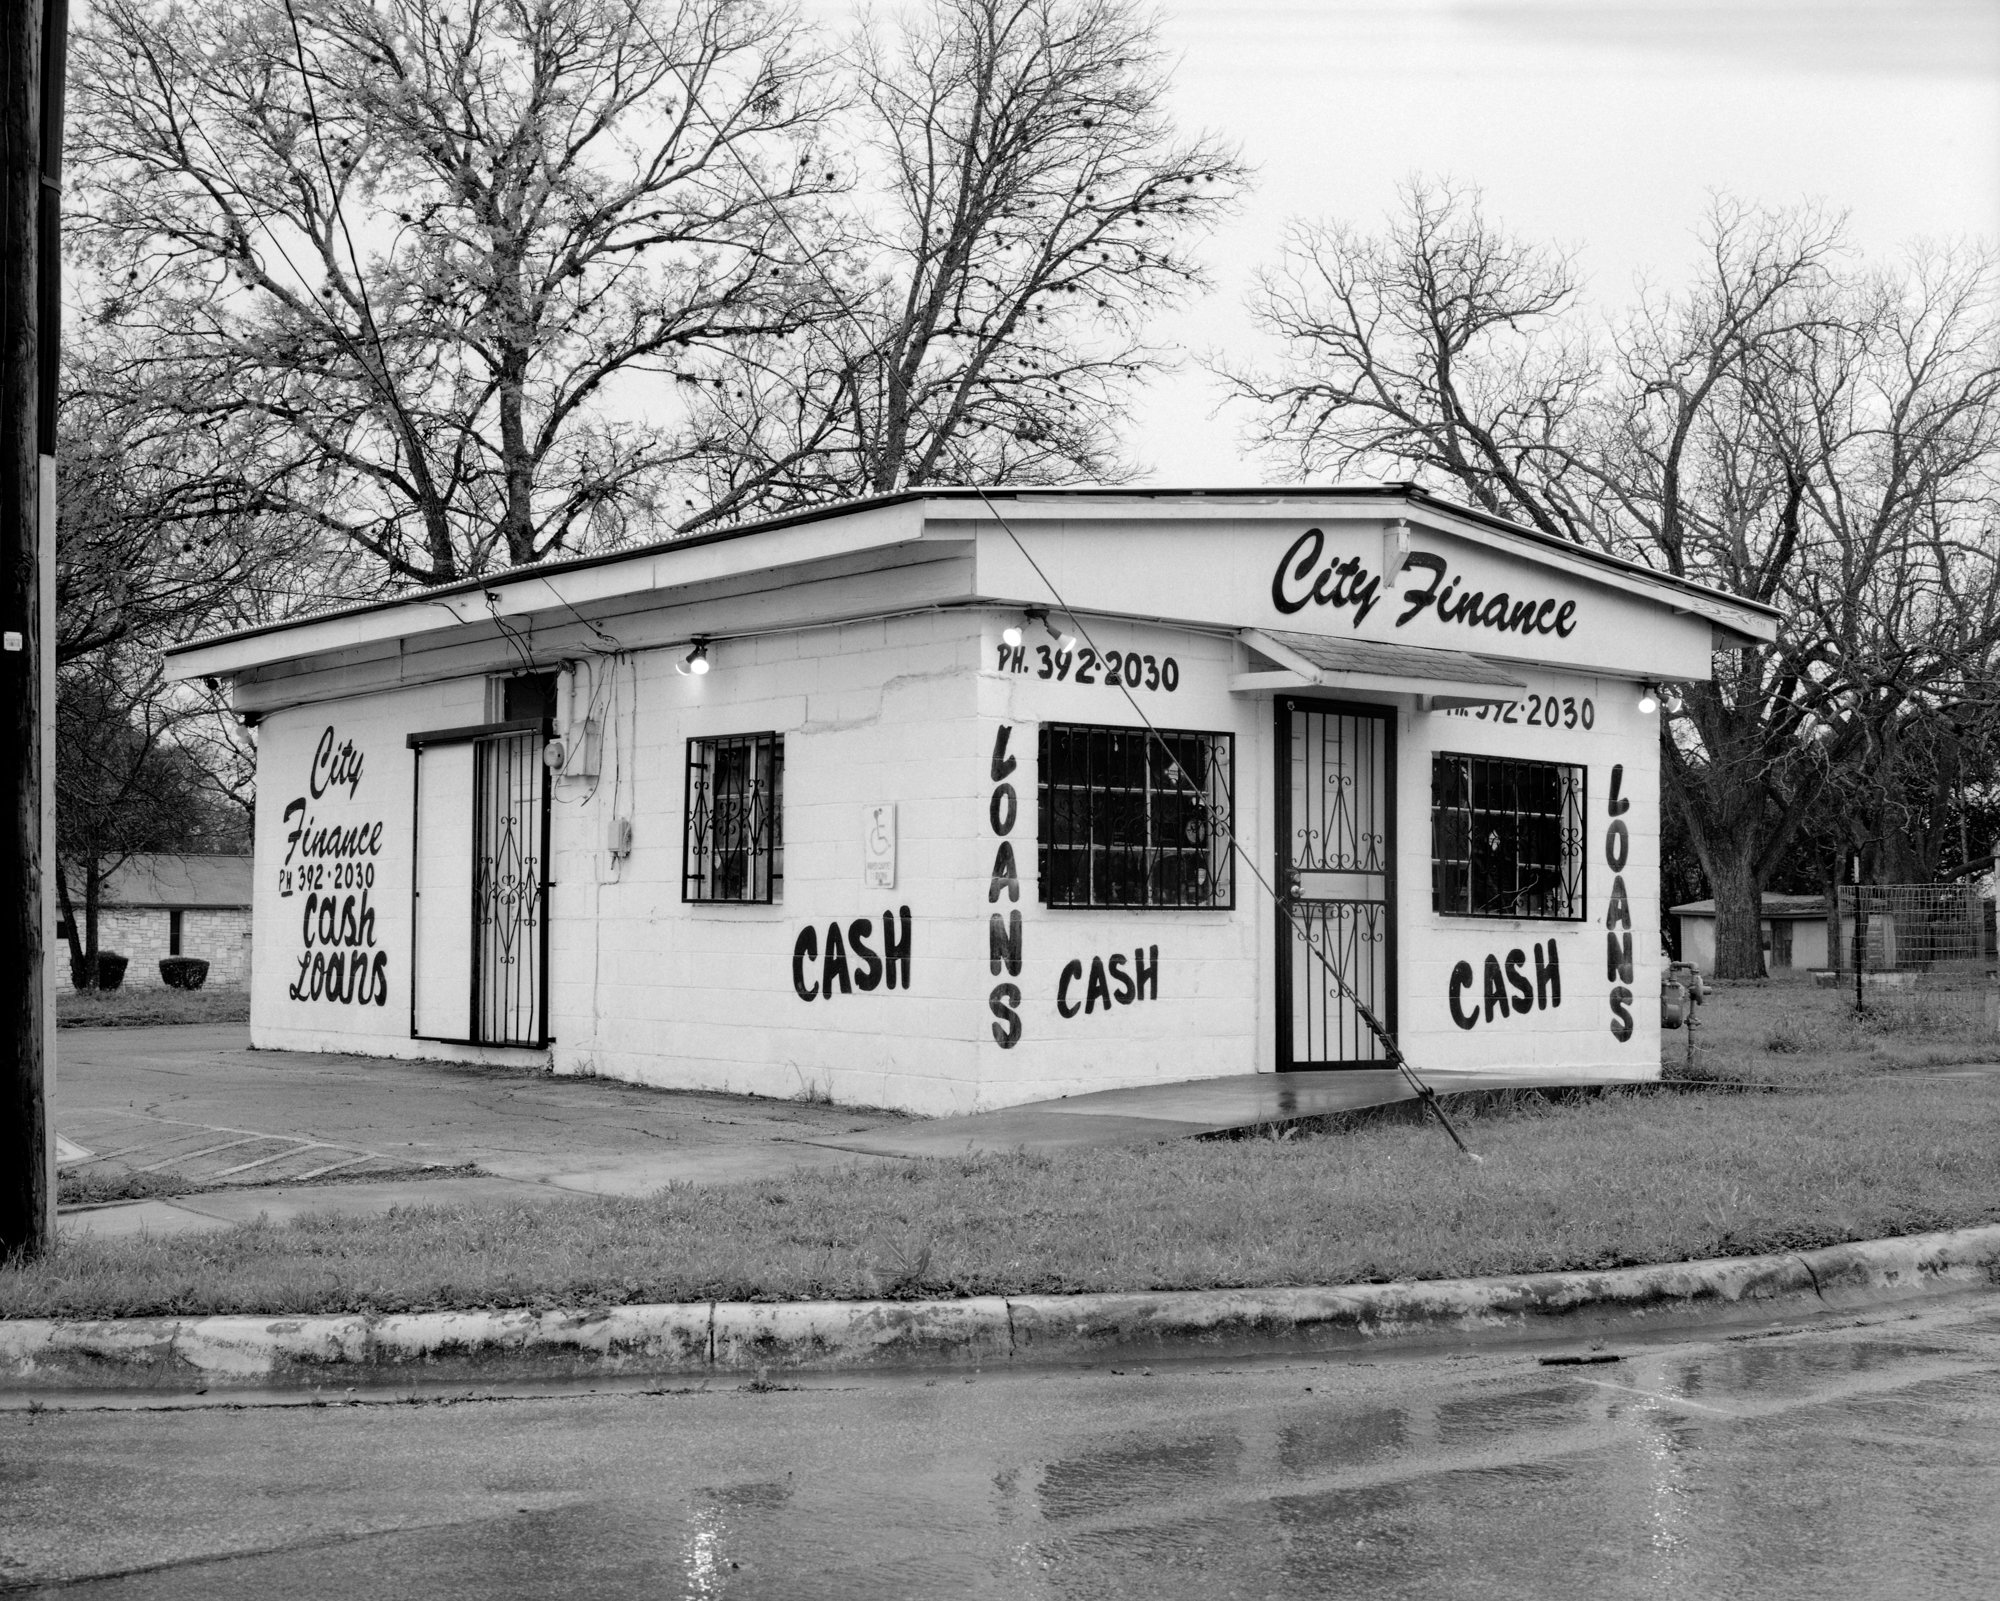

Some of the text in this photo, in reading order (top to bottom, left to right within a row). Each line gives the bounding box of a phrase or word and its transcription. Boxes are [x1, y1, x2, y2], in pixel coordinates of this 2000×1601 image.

[1271, 527, 1578, 638] City Finance
[997, 642, 1029, 674] PH.
[309, 725, 365, 801] City
[283, 796, 383, 867] Finance
[278, 868, 294, 895] PH
[988, 724, 1022, 1049] LOANS
[1605, 763, 1634, 1043] LOANS
[792, 904, 912, 1002] CASH
[1057, 944, 1159, 1018] CASH
[1448, 937, 1562, 1031] CASH
